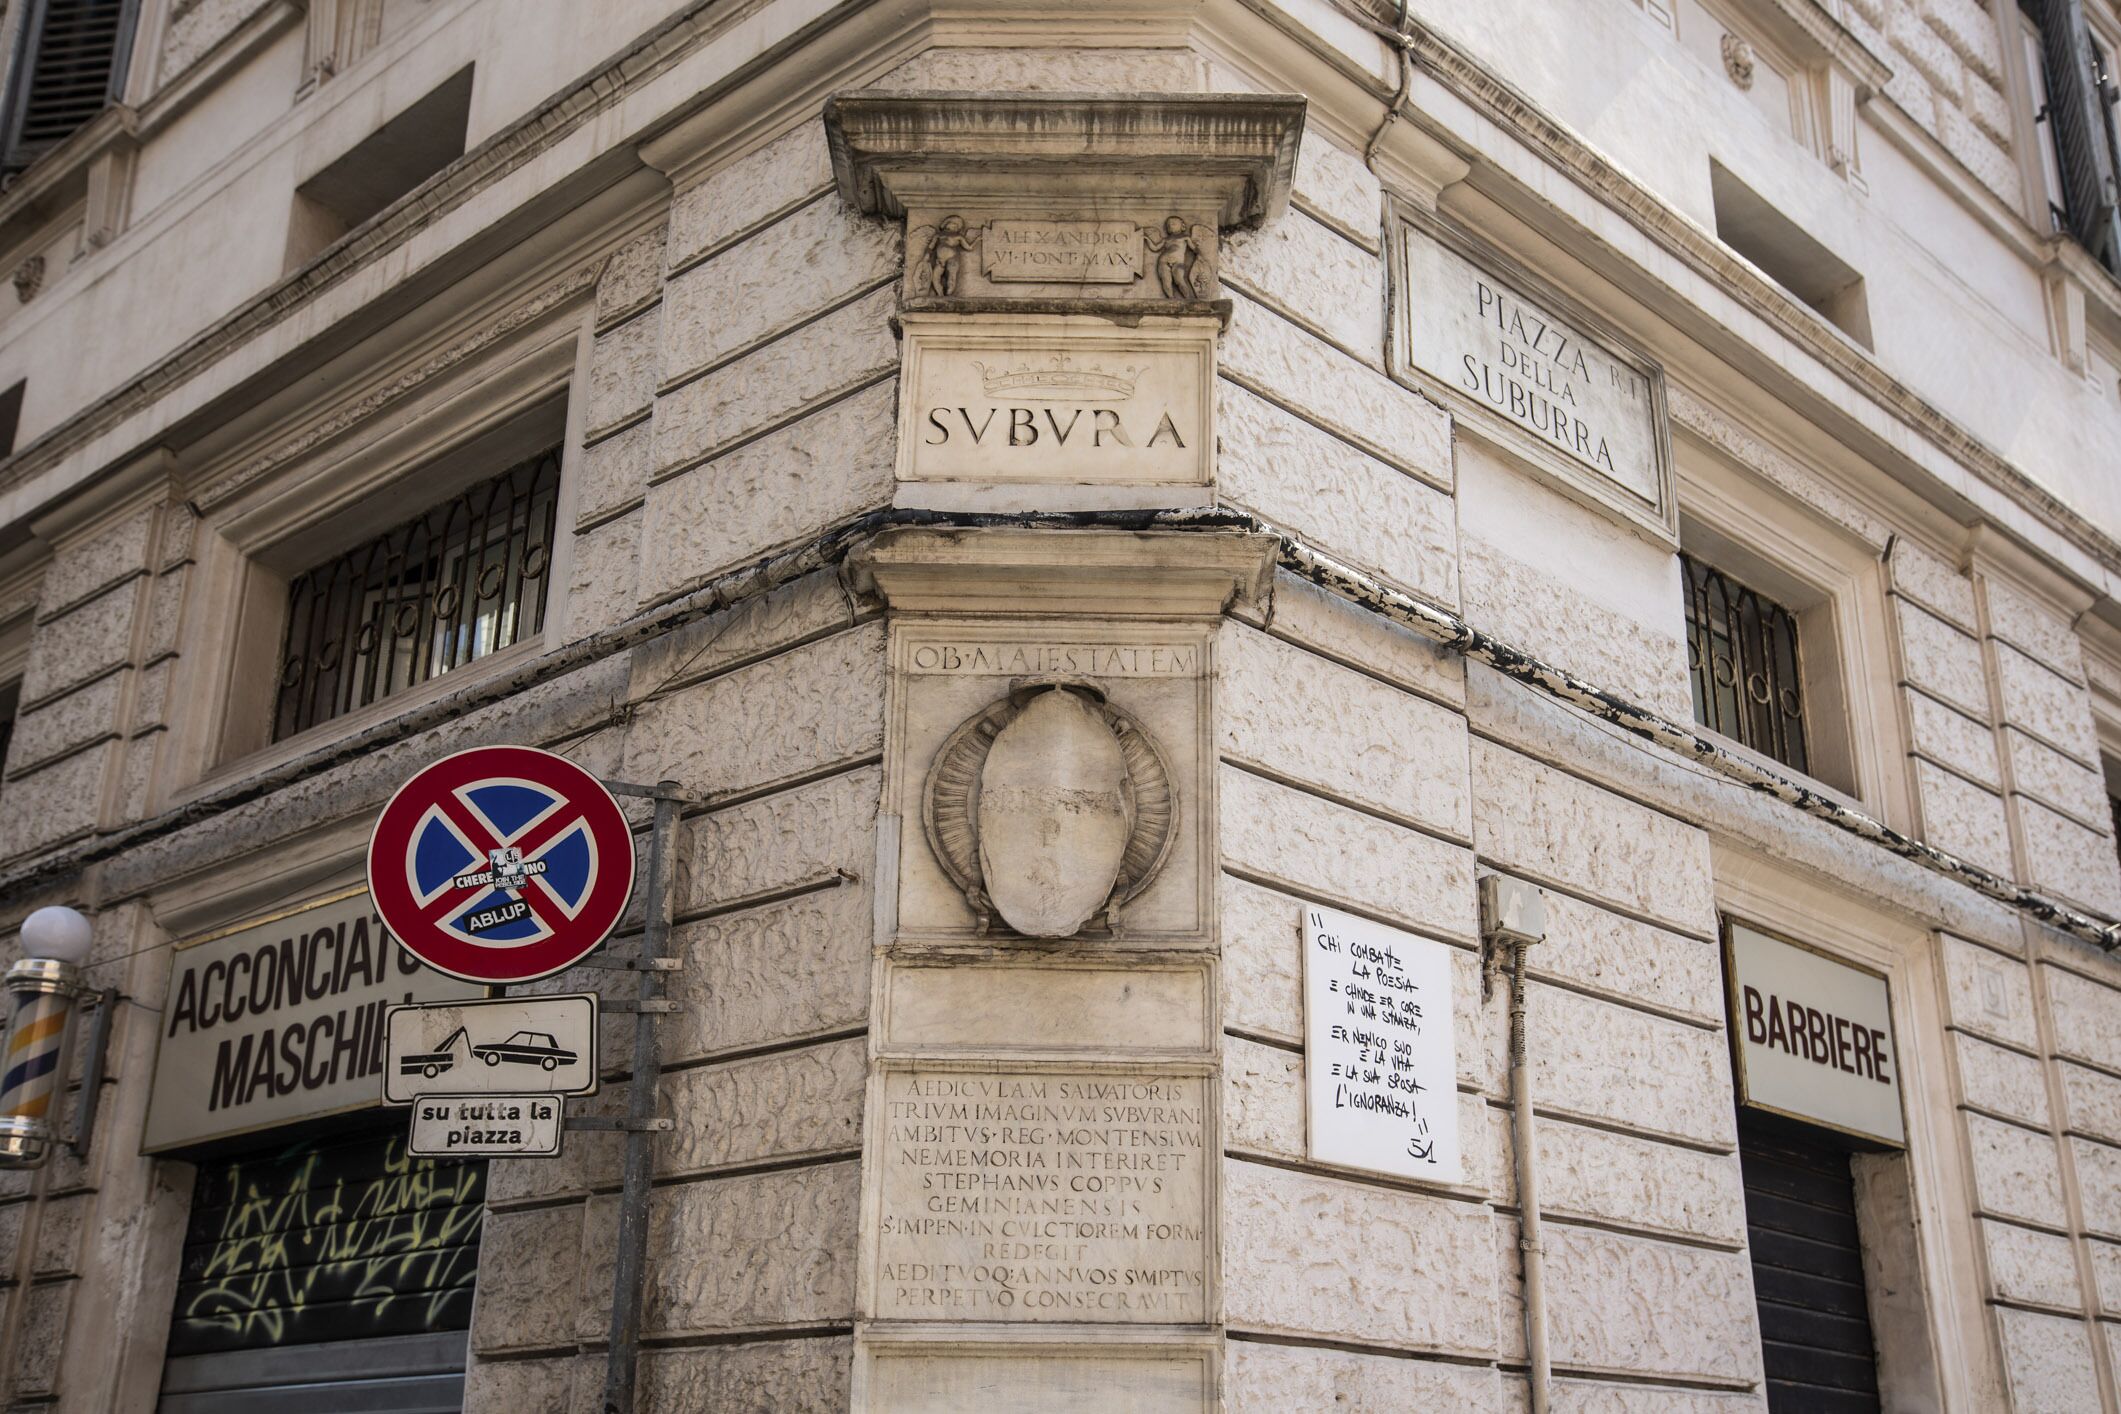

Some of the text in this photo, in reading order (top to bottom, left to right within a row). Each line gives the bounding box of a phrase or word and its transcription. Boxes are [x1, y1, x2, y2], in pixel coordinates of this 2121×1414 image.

[999, 229, 1129, 246] ALEXANDRO
[1476, 280, 1592, 384] PIAZZA
[1499, 340, 1577, 407] DELLA
[1462, 353, 1616, 472] SUBURRA
[924, 406, 1187, 450] SVBVRA
[972, 646, 1194, 673] MAIESTATEM
[469, 902, 526, 931] ABLUP
[1350, 942, 1404, 972] COMBATTE
[1352, 960, 1371, 980] LA
[1347, 1000, 1355, 1015] IN
[1360, 1003, 1377, 1021] UNA
[1379, 996, 1395, 1010] ER
[1400, 1000, 1423, 1018] CORE
[1331, 1025, 1412, 1057] ER NEMICO SUO
[1743, 983, 1891, 1086] BARBIERE
[208, 992, 414, 1112] MASCHIL
[1374, 1049, 1385, 1067] LA
[907, 1079, 1183, 1101] AEDICVLAM SALVATORIS
[1345, 1064, 1359, 1082] LA
[1362, 1066, 1381, 1085] SUA
[1387, 1072, 1428, 1095] SPOSA
[421, 1101, 552, 1121] su tutta la
[888, 1101, 1201, 1124] TRIVM IMAGINVM SVBVRANI
[446, 1125, 522, 1148] piazza
[1056, 1151, 1186, 1171] INTERIRET
[922, 1172, 1165, 1194] STEPHANVS COPPVS
[927, 1195, 1141, 1217] GEMINIANENSIS
[1001, 1220, 1139, 1240] CVLCTIOREM
[895, 1287, 1189, 1310] PERPETVO CONSECRAVIT
